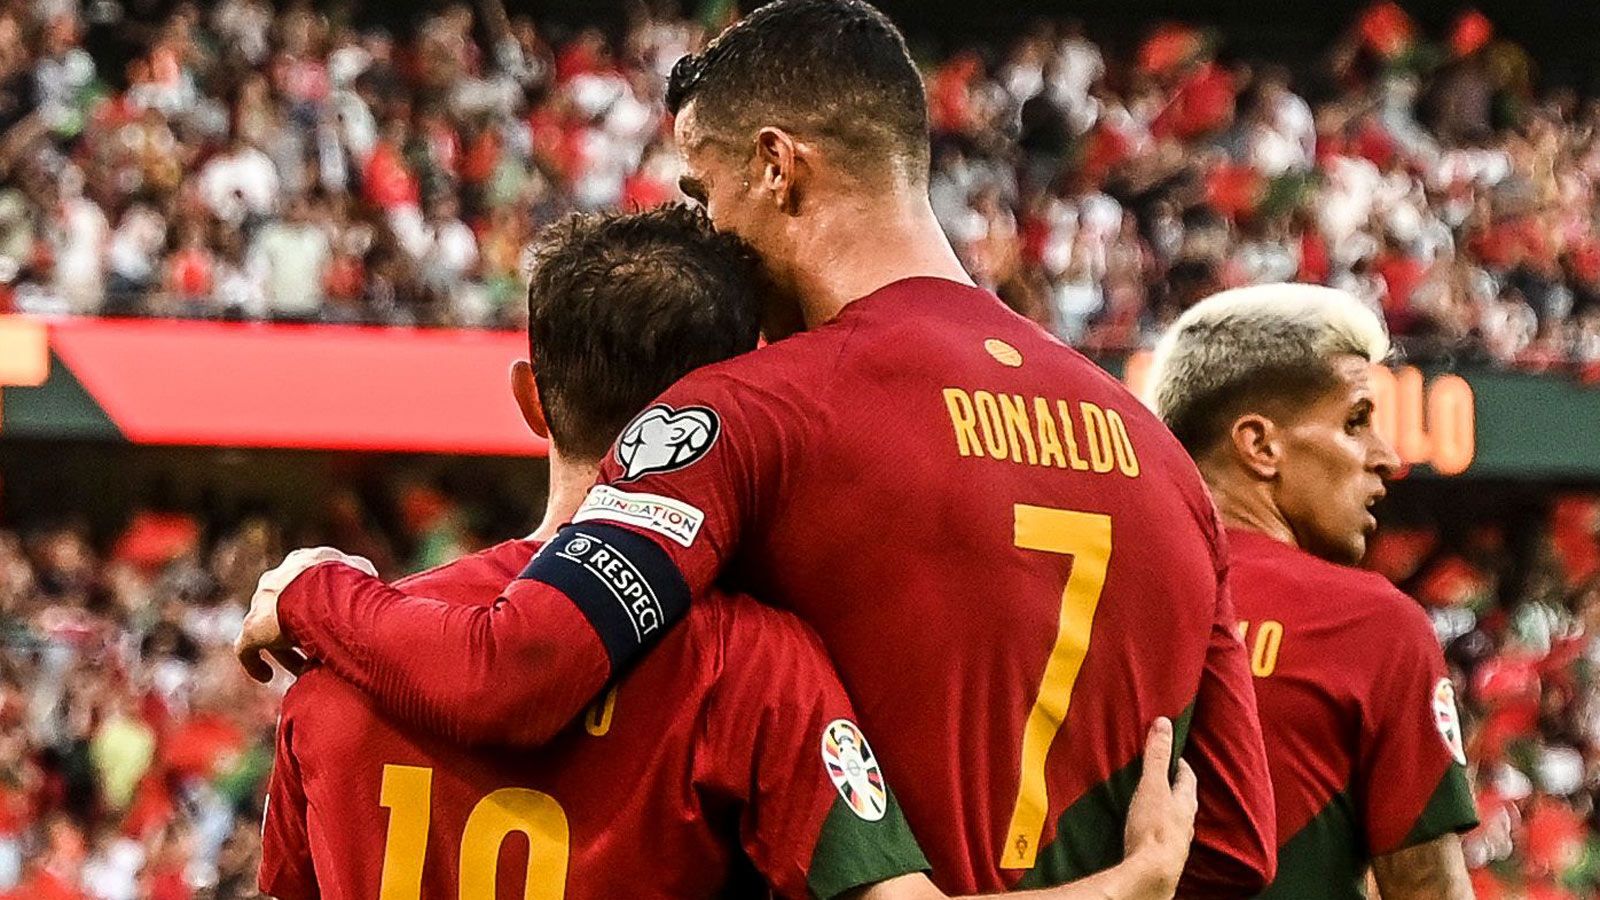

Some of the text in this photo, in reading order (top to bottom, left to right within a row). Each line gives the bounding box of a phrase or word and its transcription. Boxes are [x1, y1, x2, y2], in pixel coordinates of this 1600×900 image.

[942, 387, 1140, 478] RONALDO
[587, 496, 697, 534] OUNDATION
[589, 549, 659, 635] RESPECT
[999, 502, 1113, 869] 7
